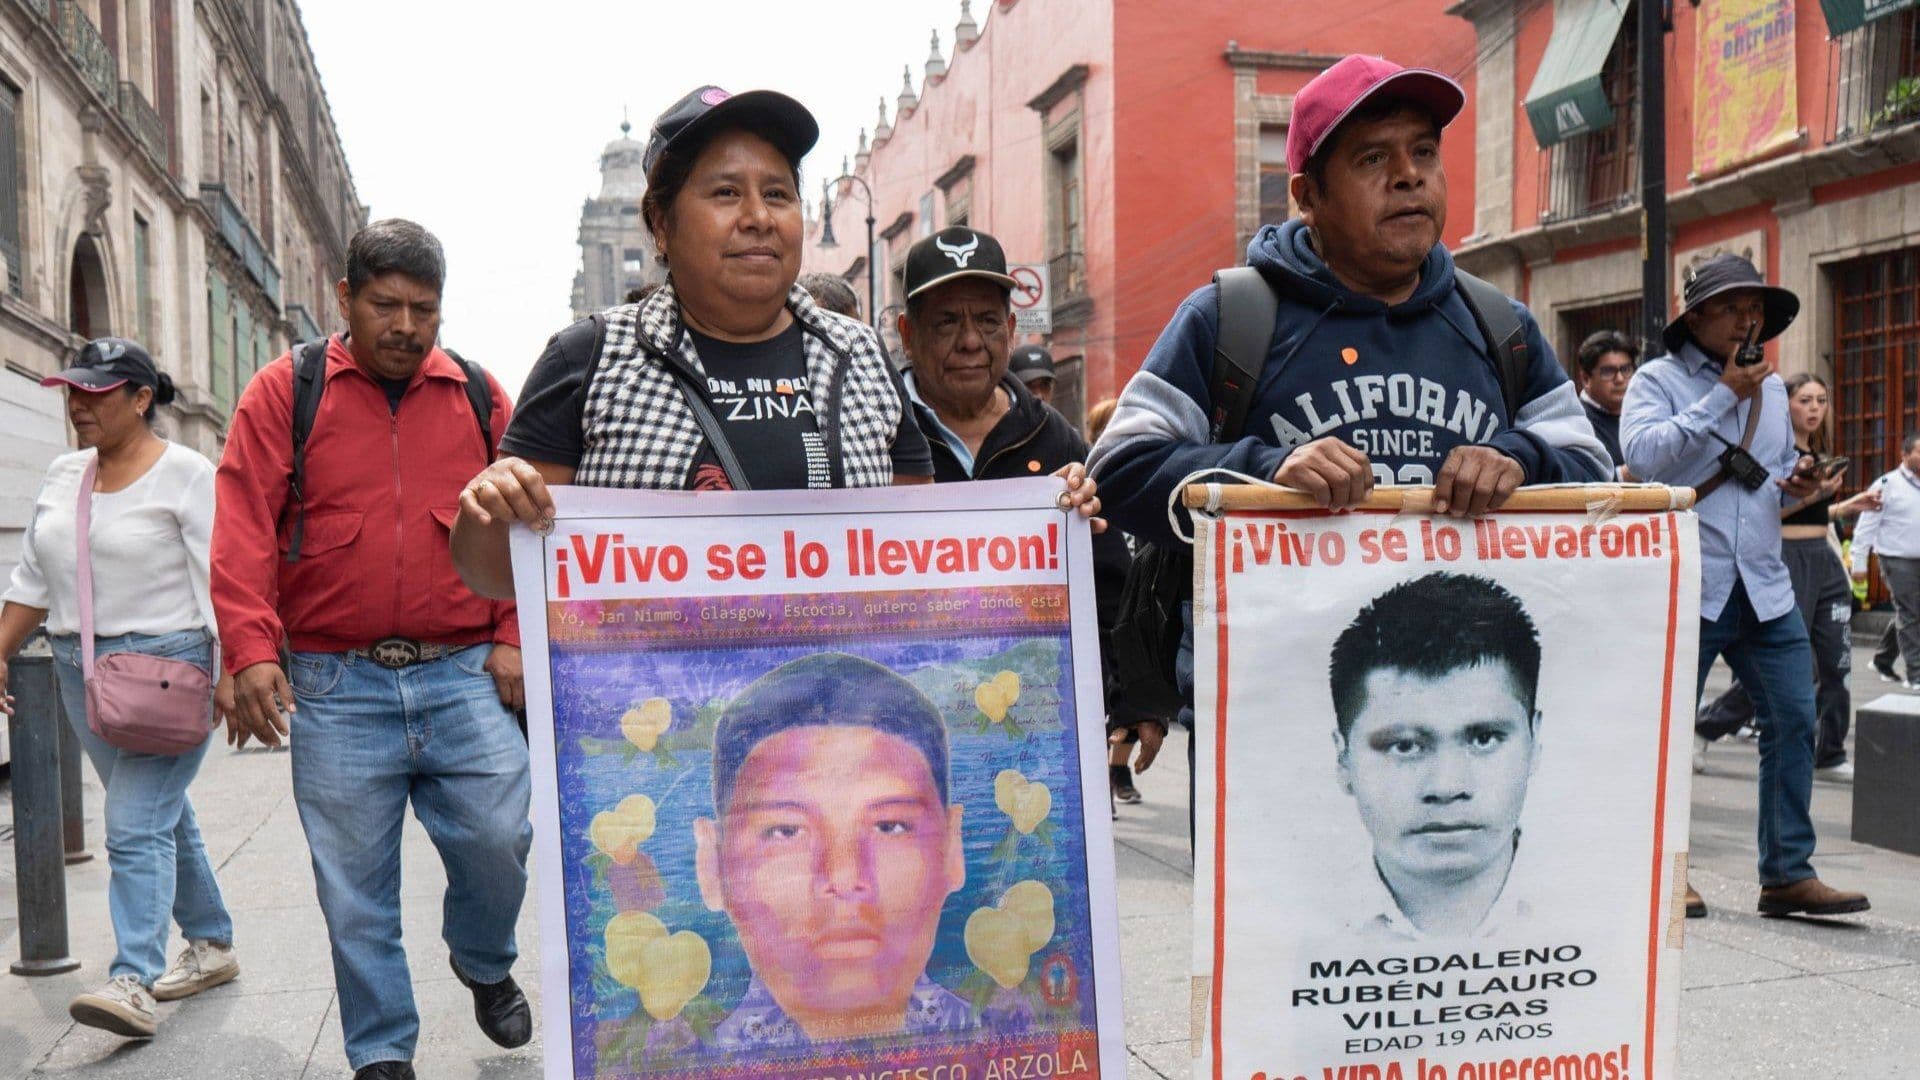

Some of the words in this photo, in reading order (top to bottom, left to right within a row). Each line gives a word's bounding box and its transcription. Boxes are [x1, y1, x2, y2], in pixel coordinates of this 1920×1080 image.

[746, 378, 772, 392] NI
[1353, 429, 1441, 458] SINCE.
[556, 533, 689, 598] ¡Vivo
[706, 543, 766, 580] se
[784, 530, 829, 578] lo
[846, 523, 1059, 576] llevaron!
[1231, 523, 1345, 573] ¡Vivo
[1359, 528, 1408, 563] se
[1421, 519, 1461, 561] lo
[1475, 517, 1662, 560] llevaron!
[558, 612, 585, 627] Yo,
[635, 610, 689, 623] Nimmo,
[700, 606, 773, 622] Glasgow,
[783, 602, 854, 617] Escocia,
[863, 600, 918, 615] quiero
[927, 600, 970, 613] saber
[1310, 945, 1582, 978] MAGDALENO
[1292, 980, 1443, 1007] RUBÉN
[1458, 969, 1598, 996] LAURO
[1342, 999, 1548, 1030] VILLEGAS
[1345, 1034, 1423, 1054] EDAD
[1435, 1030, 1466, 1047] 19
[1476, 1022, 1553, 1043] AÑOS
[985, 1050, 1088, 1080] ARZOLA
